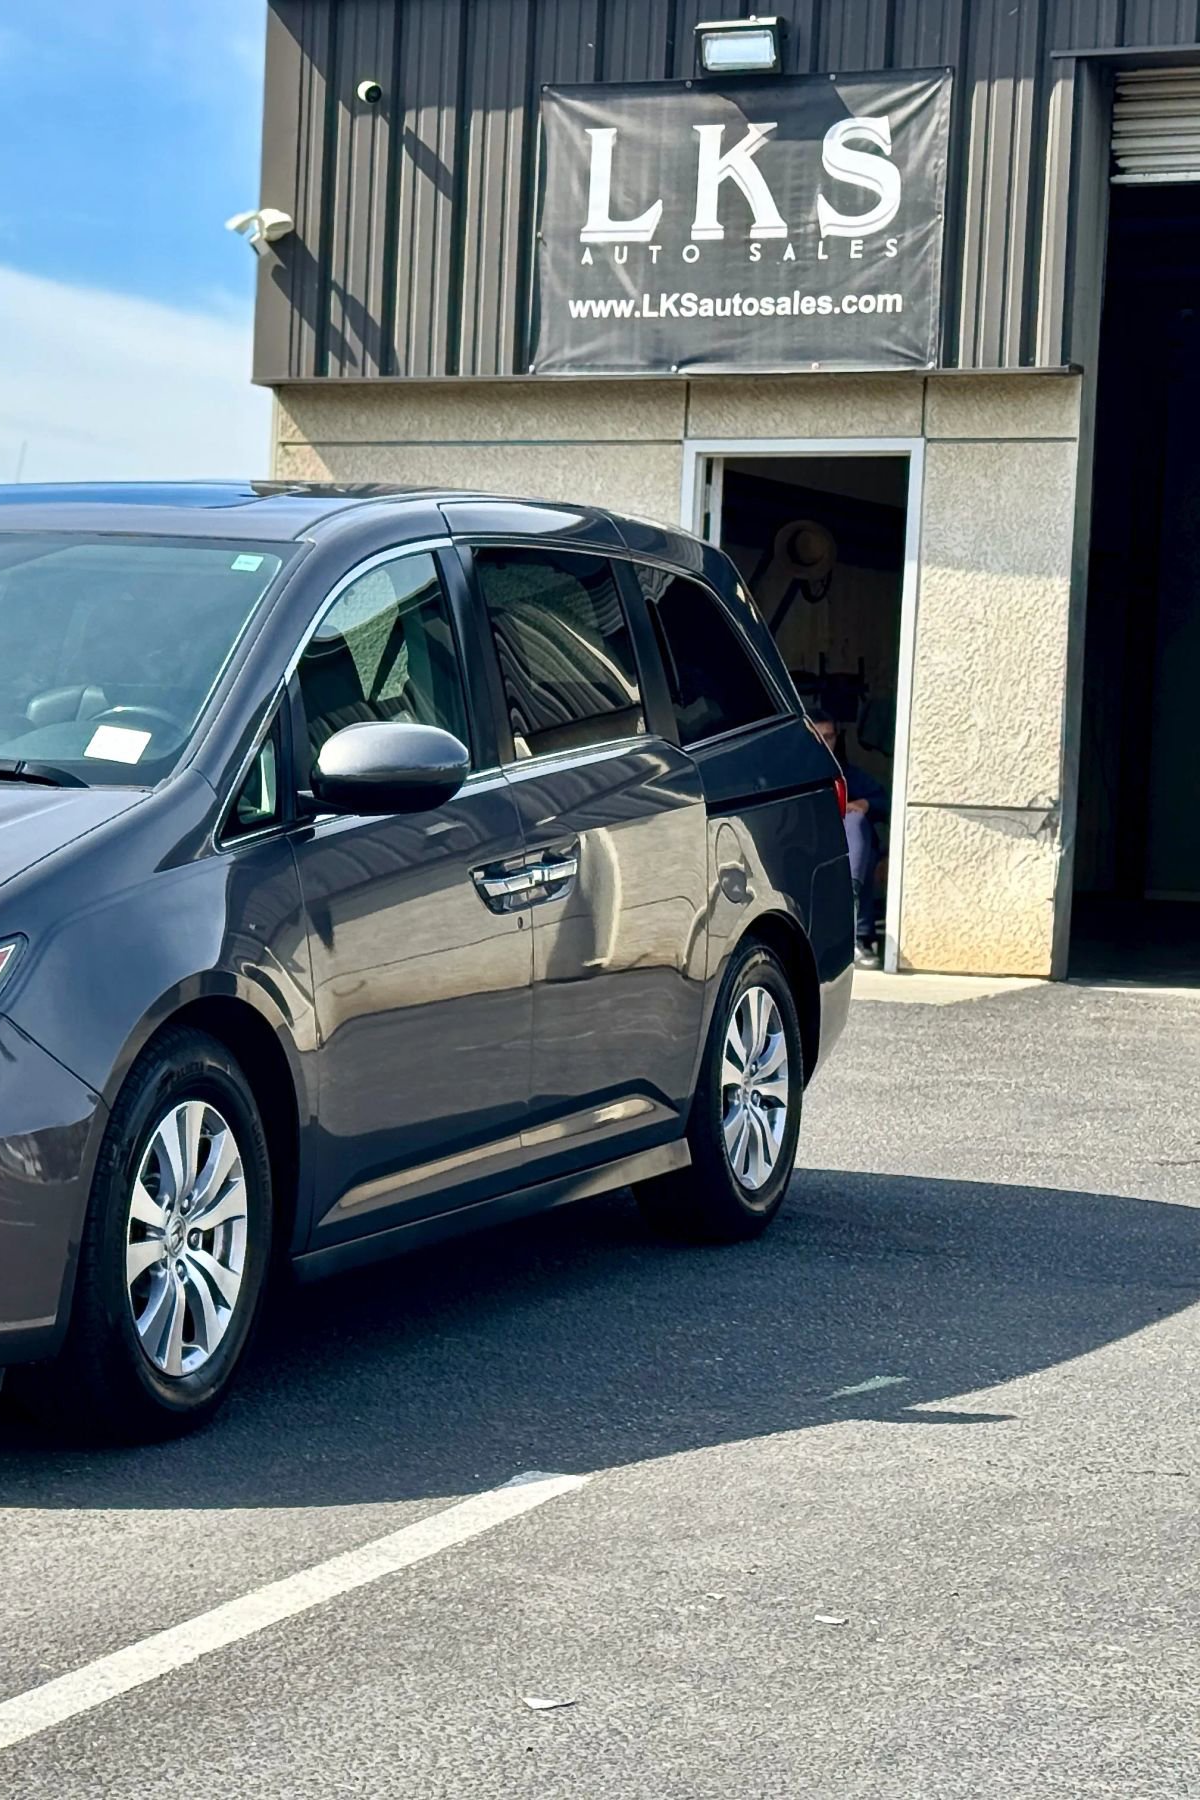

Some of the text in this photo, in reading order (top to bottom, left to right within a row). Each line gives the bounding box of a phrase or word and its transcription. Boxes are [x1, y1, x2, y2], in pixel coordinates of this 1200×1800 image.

[580, 116, 901, 242] LKS
[580, 239, 899, 266] AUTO SALES
[568, 290, 902, 319] www.LKSautosales.com
